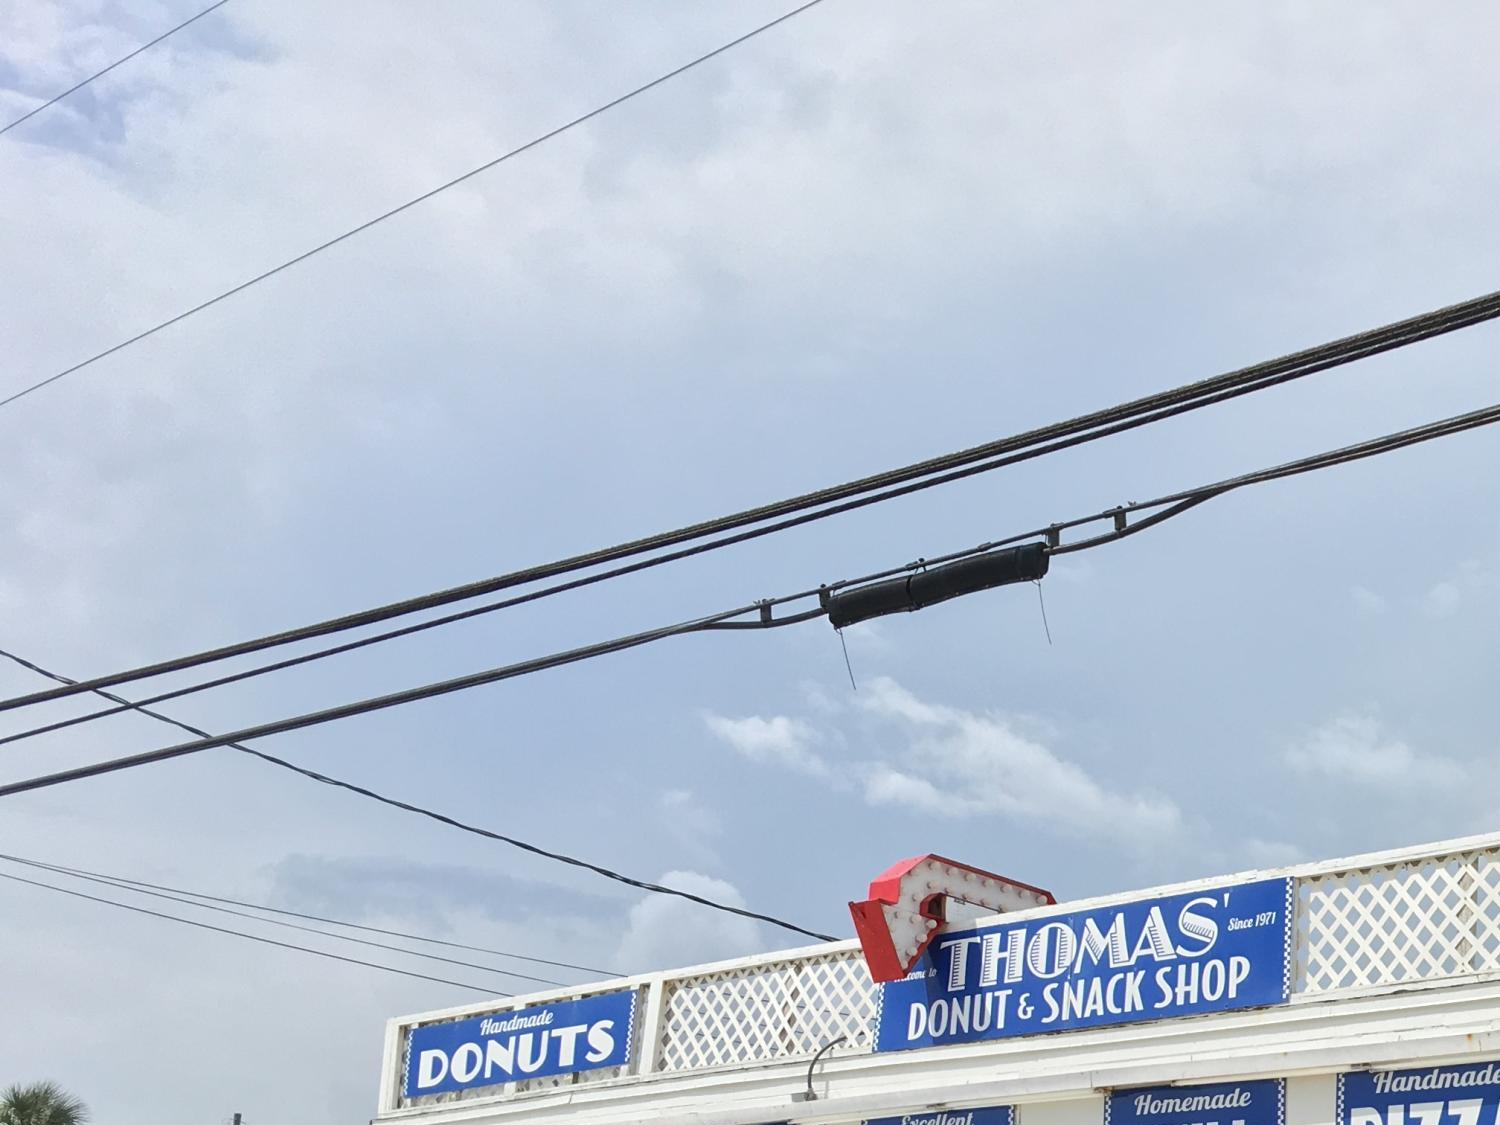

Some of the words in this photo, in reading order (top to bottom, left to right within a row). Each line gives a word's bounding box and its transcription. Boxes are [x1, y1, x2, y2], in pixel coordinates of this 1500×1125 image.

[940, 892, 1230, 992] THOMAS'
[1228, 917, 1253, 932] Since
[1255, 911, 1276, 927] 1971
[907, 988, 1012, 1040] DONUT
[1018, 993, 1035, 1020] &
[1040, 969, 1146, 1024] SNACK
[1155, 955, 1250, 1008] SHOP
[480, 1010, 553, 1036] Handmade
[417, 1019, 615, 1089] DONUTS
[1134, 1088, 1252, 1116] Homemade
